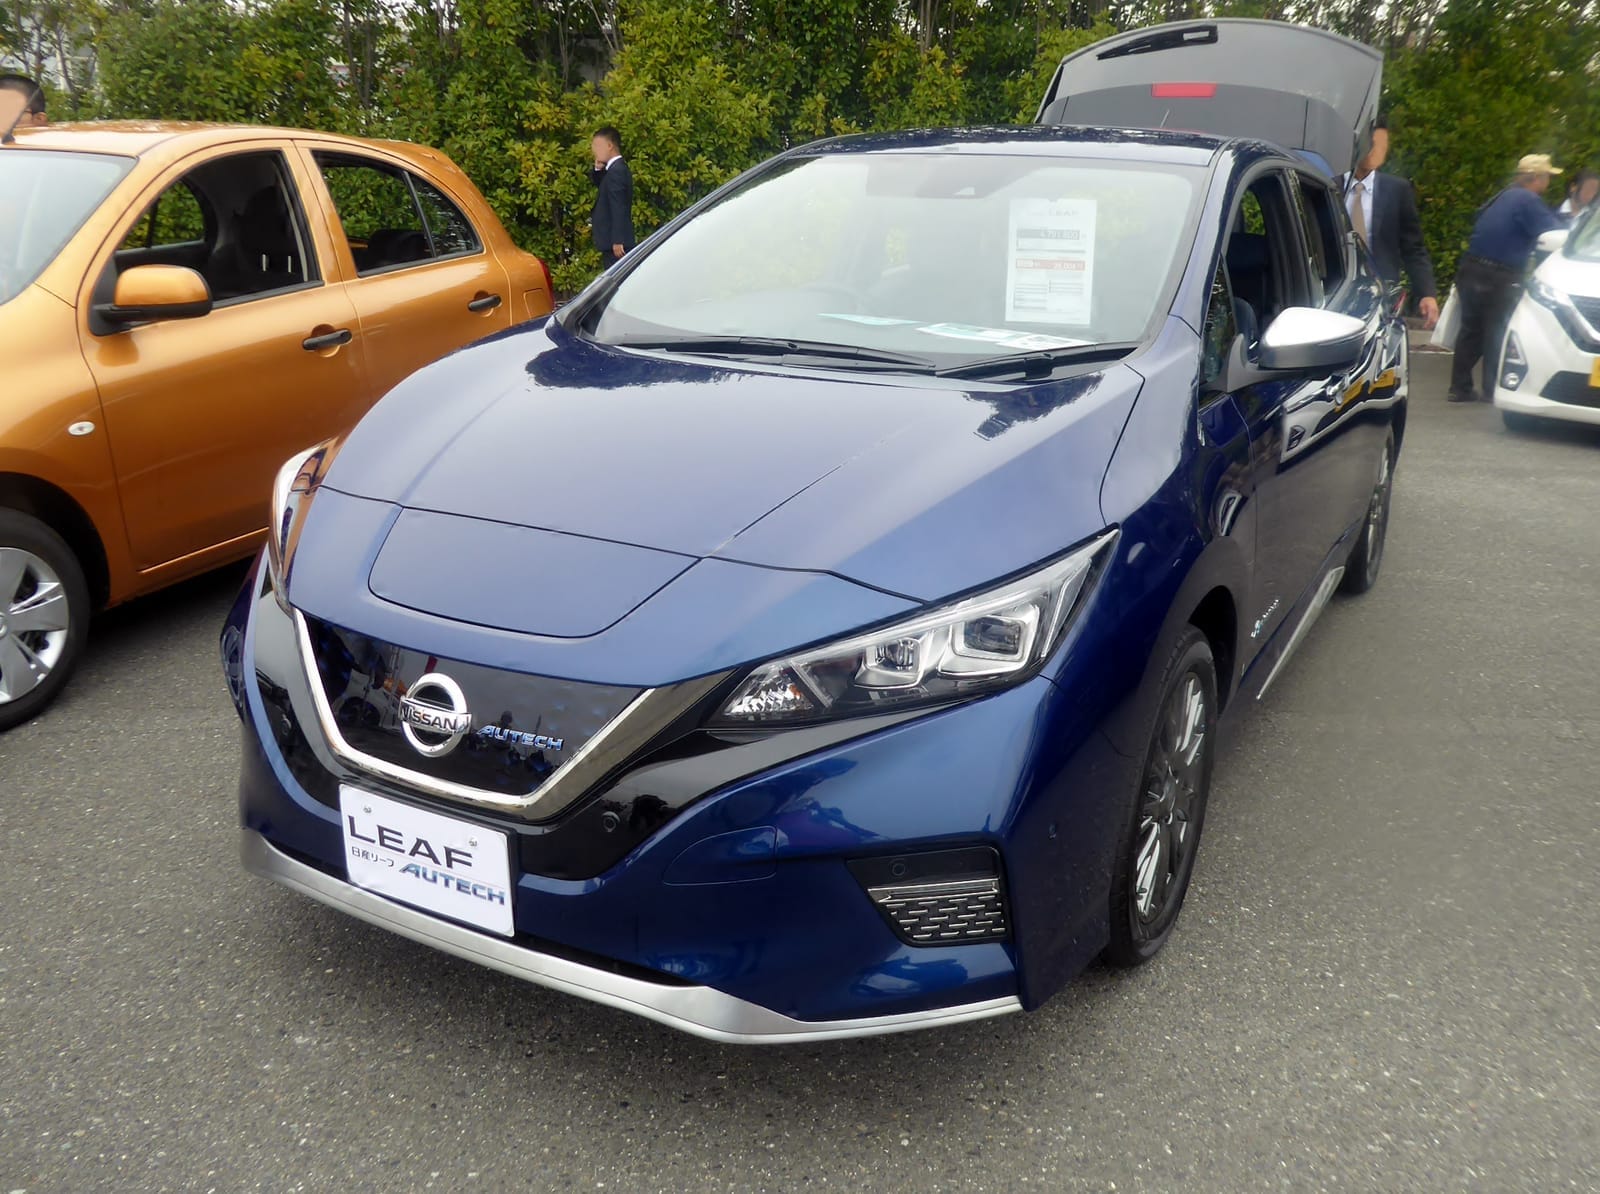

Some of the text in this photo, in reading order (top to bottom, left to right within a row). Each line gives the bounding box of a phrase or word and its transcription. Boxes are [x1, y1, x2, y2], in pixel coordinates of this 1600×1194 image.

[401, 702, 457, 731] NISSAN
[476, 725, 565, 751] AUTECH
[348, 815, 473, 869] LEAF
[351, 846, 395, 867] 日産リーフ
[399, 863, 505, 906] AUTECH
